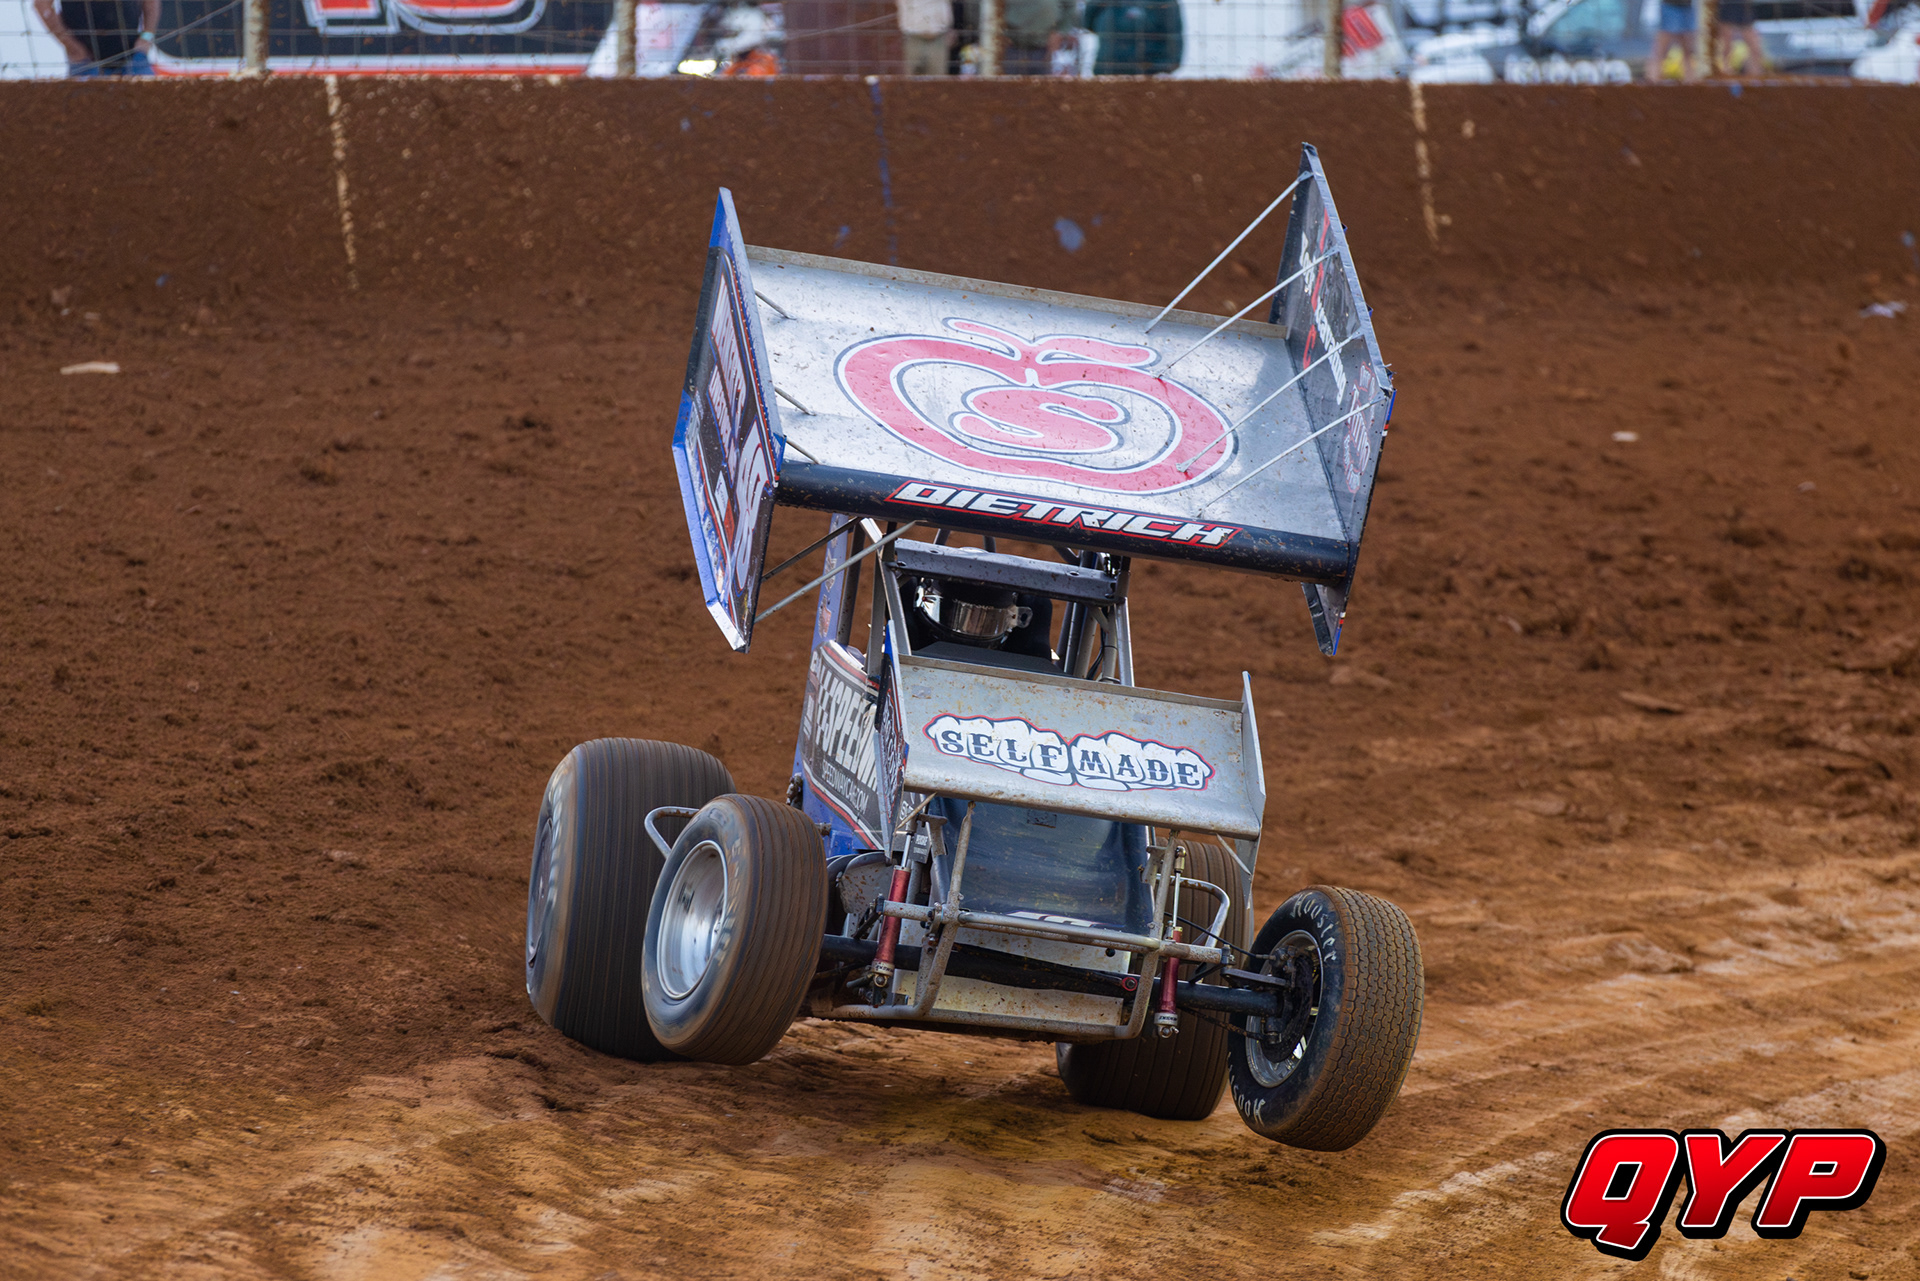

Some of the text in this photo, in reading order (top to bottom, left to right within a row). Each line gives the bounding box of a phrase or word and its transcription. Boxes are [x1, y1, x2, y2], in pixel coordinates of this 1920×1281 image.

[736, 419, 770, 591] 48
[893, 482, 1237, 546] DIETRICH
[940, 730, 1200, 787] SELF MADE
